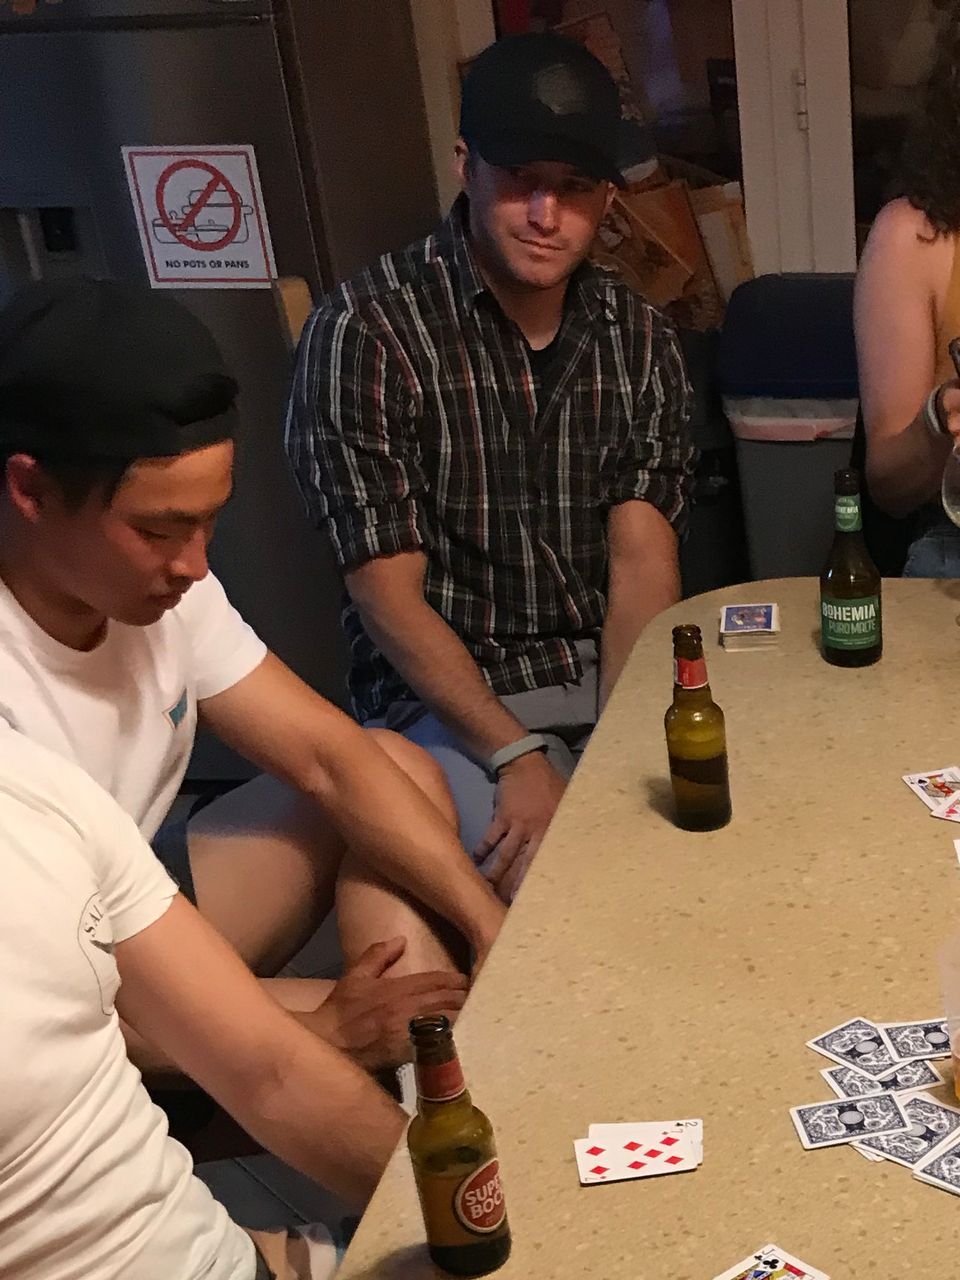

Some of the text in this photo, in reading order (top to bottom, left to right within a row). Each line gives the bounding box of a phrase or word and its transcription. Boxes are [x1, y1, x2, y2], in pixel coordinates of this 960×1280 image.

[165, 260, 250, 269] NO POTS OR PANS
[822, 601, 876, 621] BOHEMIA
[471, 1189, 504, 1219] BOC
